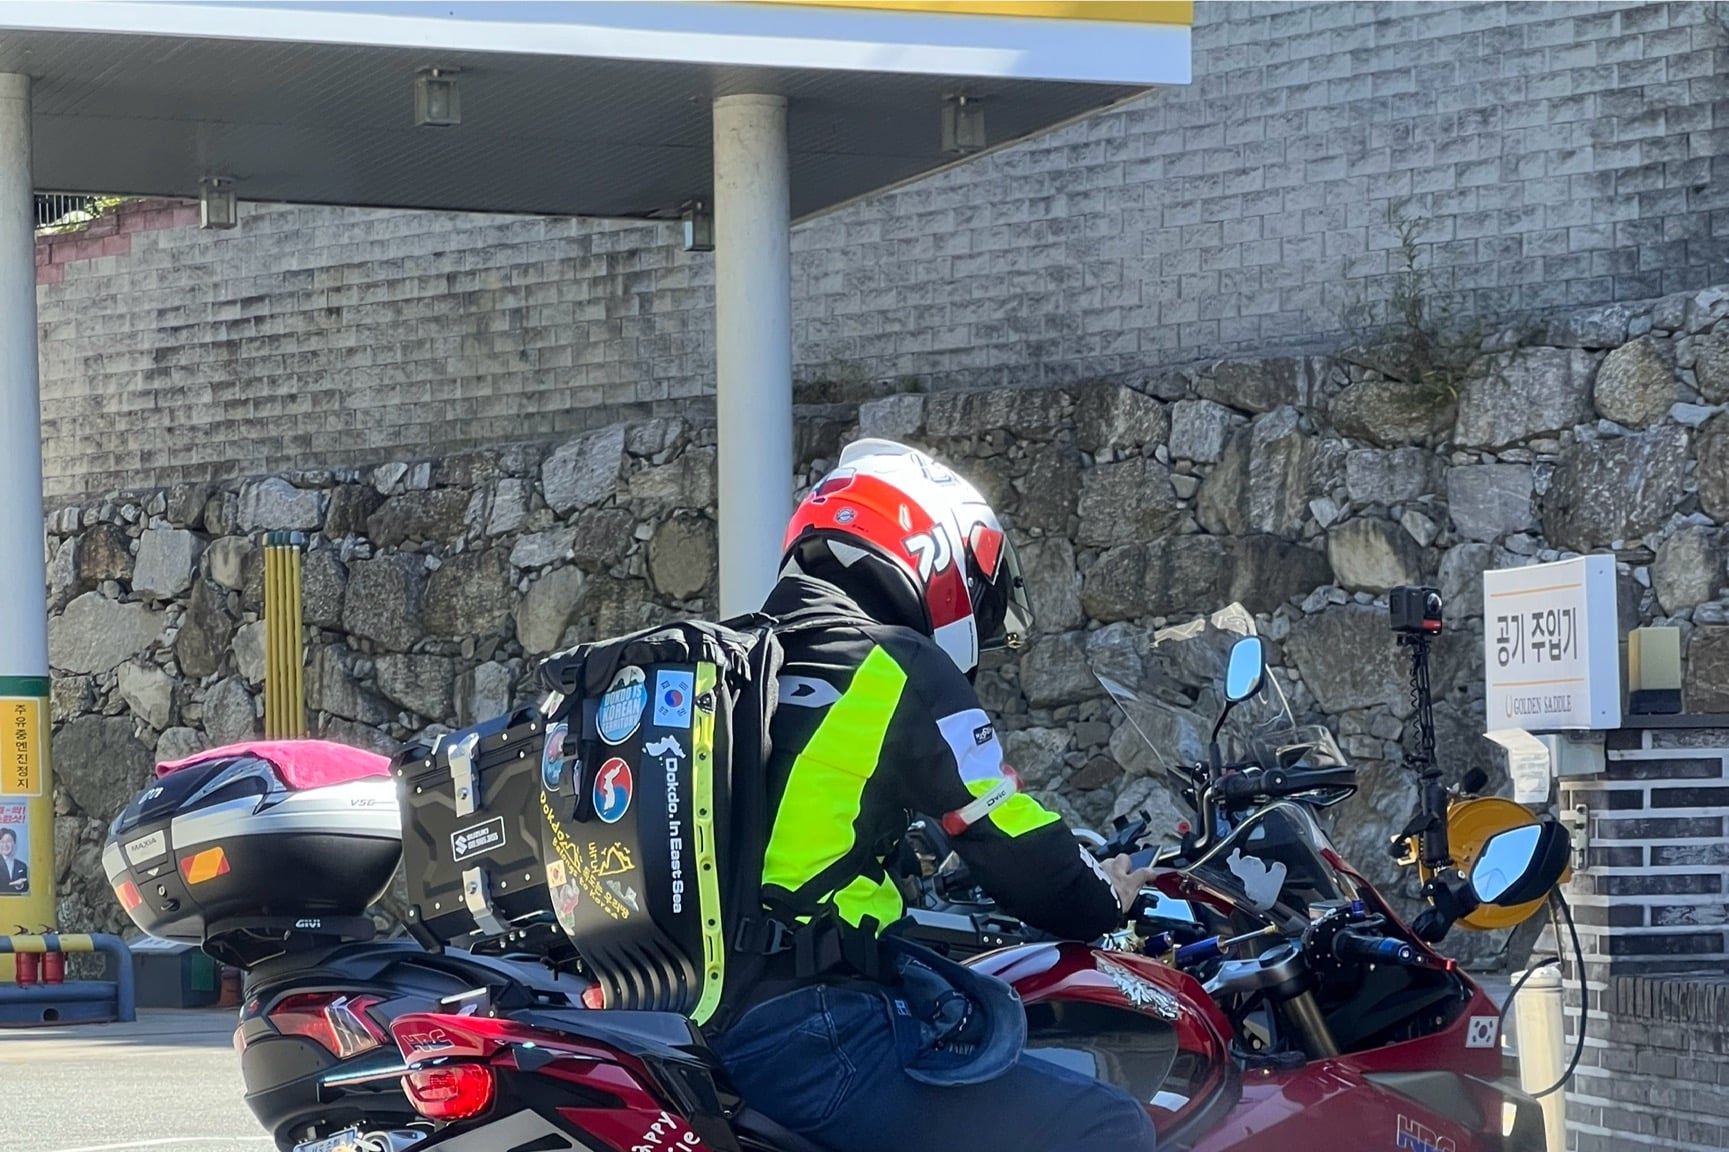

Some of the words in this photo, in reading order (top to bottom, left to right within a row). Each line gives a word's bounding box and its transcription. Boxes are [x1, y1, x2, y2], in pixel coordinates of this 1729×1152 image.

[1496, 612, 1526, 667] 공기
[1531, 607, 1578, 664] 주입기
[604, 686, 631, 706] DOKDO
[632, 685, 641, 700] IS
[1513, 697, 1542, 716] GOLDEN
[1543, 694, 1573, 714] SADDLE
[603, 701, 641, 721] KOREAN
[14, 703, 29, 789] 주유중엔진정지
[665, 757, 681, 819] Dokdo.
[540, 790, 565, 841] Dokdo
[669, 820, 682, 836] In
[131, 837, 157, 852] MAXIA
[670, 837, 683, 879] East
[589, 890, 618, 920] Korea
[671, 880, 684, 914] Sea
[295, 919, 321, 928] GIVI
[400, 1028, 455, 1052] HRC
